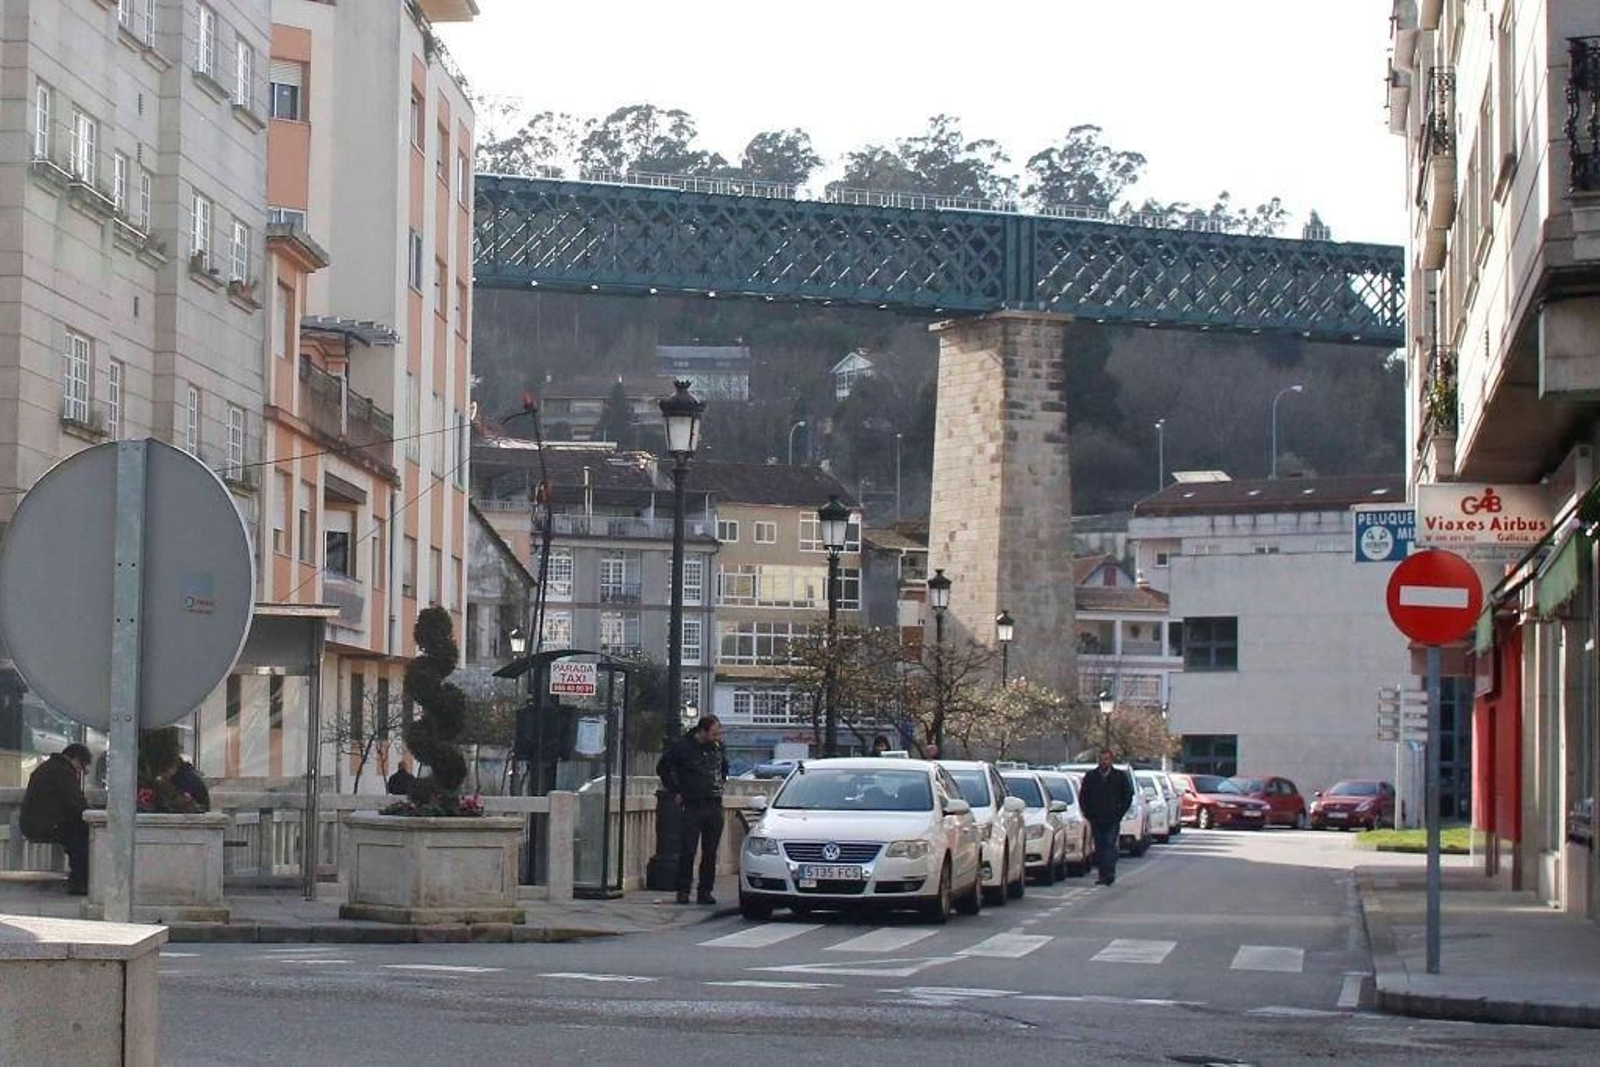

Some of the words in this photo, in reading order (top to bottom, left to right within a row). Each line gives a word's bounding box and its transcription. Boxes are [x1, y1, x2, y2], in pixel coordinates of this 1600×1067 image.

[1358, 511, 1415, 526] PELUQUE
[1425, 516, 1485, 531] Viaxes
[1490, 516, 1547, 531] Airbus
[552, 664, 593, 673] PARADA
[560, 673, 586, 683] TAXI
